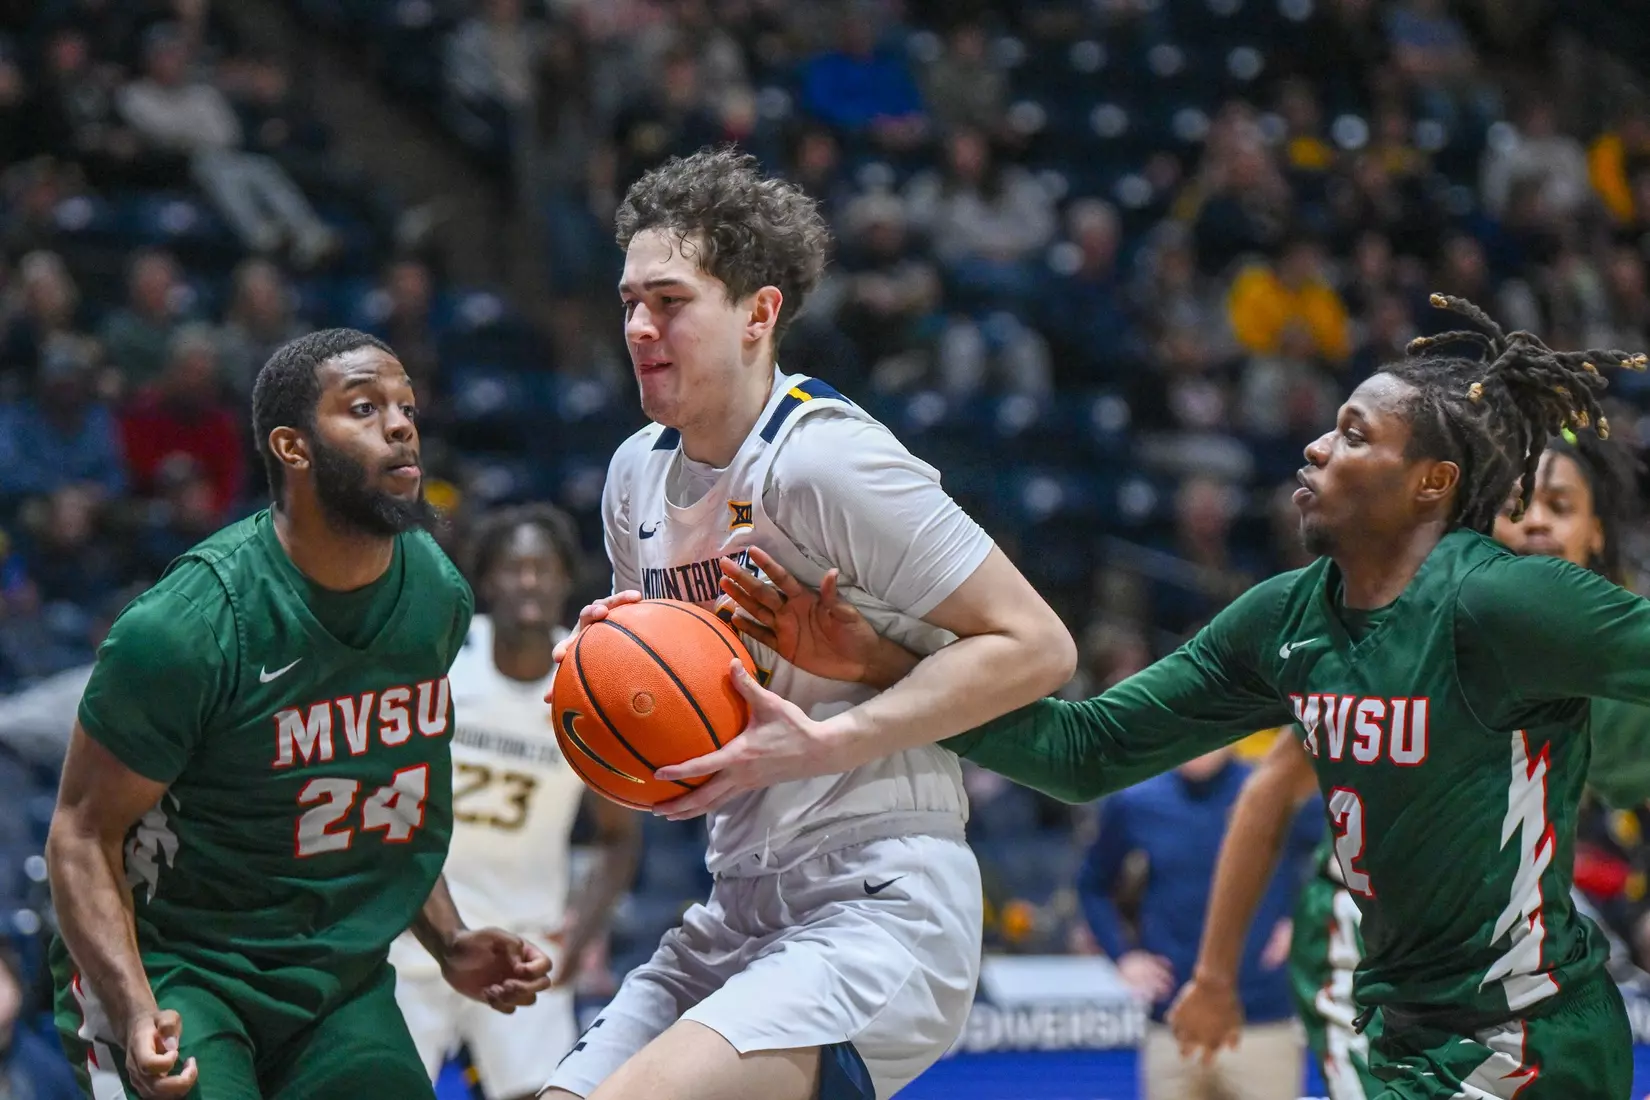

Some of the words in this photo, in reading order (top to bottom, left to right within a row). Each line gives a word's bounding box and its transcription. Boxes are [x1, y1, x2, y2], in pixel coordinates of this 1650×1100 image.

[272, 675, 449, 769] MVSU
[1288, 692, 1430, 767] MVSU
[294, 762, 429, 858] 24
[452, 762, 537, 833] 23
[1328, 785, 1377, 899] 2
